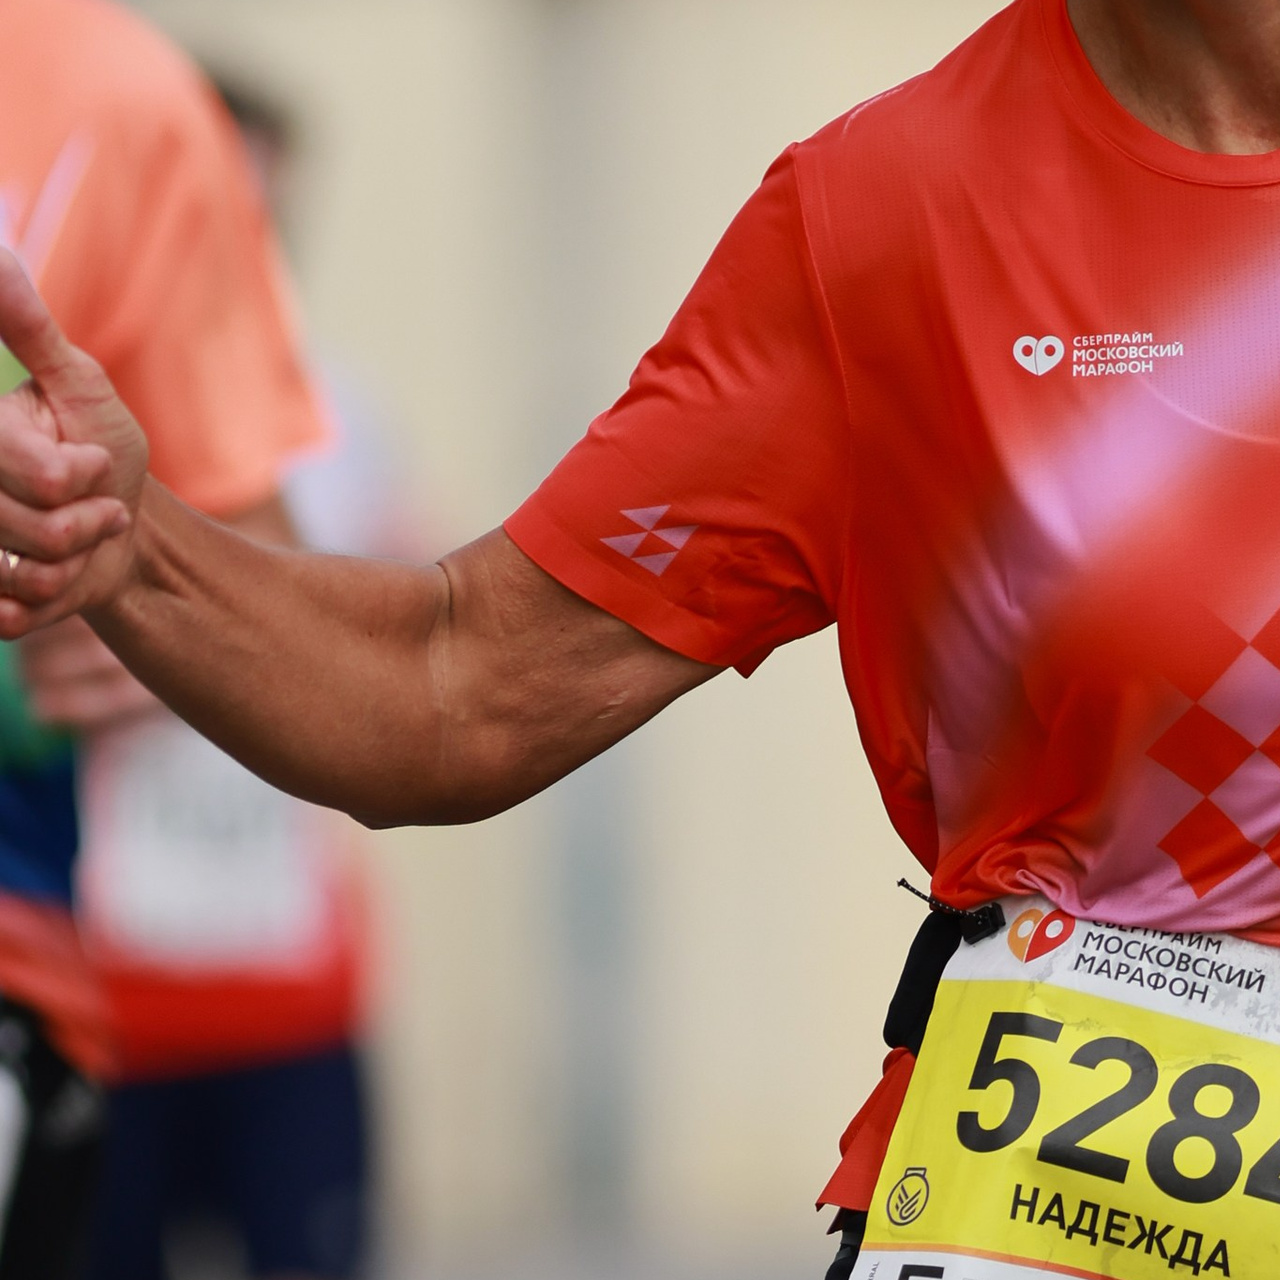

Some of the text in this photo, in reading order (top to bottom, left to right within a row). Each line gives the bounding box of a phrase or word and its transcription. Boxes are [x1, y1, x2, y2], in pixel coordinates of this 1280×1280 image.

[1072, 341, 1184, 362] МОСКОВСКИЙ
[1073, 331, 1153, 347] СБЕРПРАЙМ
[1072, 360, 1153, 377] МАРАФОН
[1073, 953, 1209, 1003] МАРАФОН
[1082, 931, 1265, 993] МОСКОВСКИЙ
[1009, 1183, 1232, 1278] НАДЕЖДА
